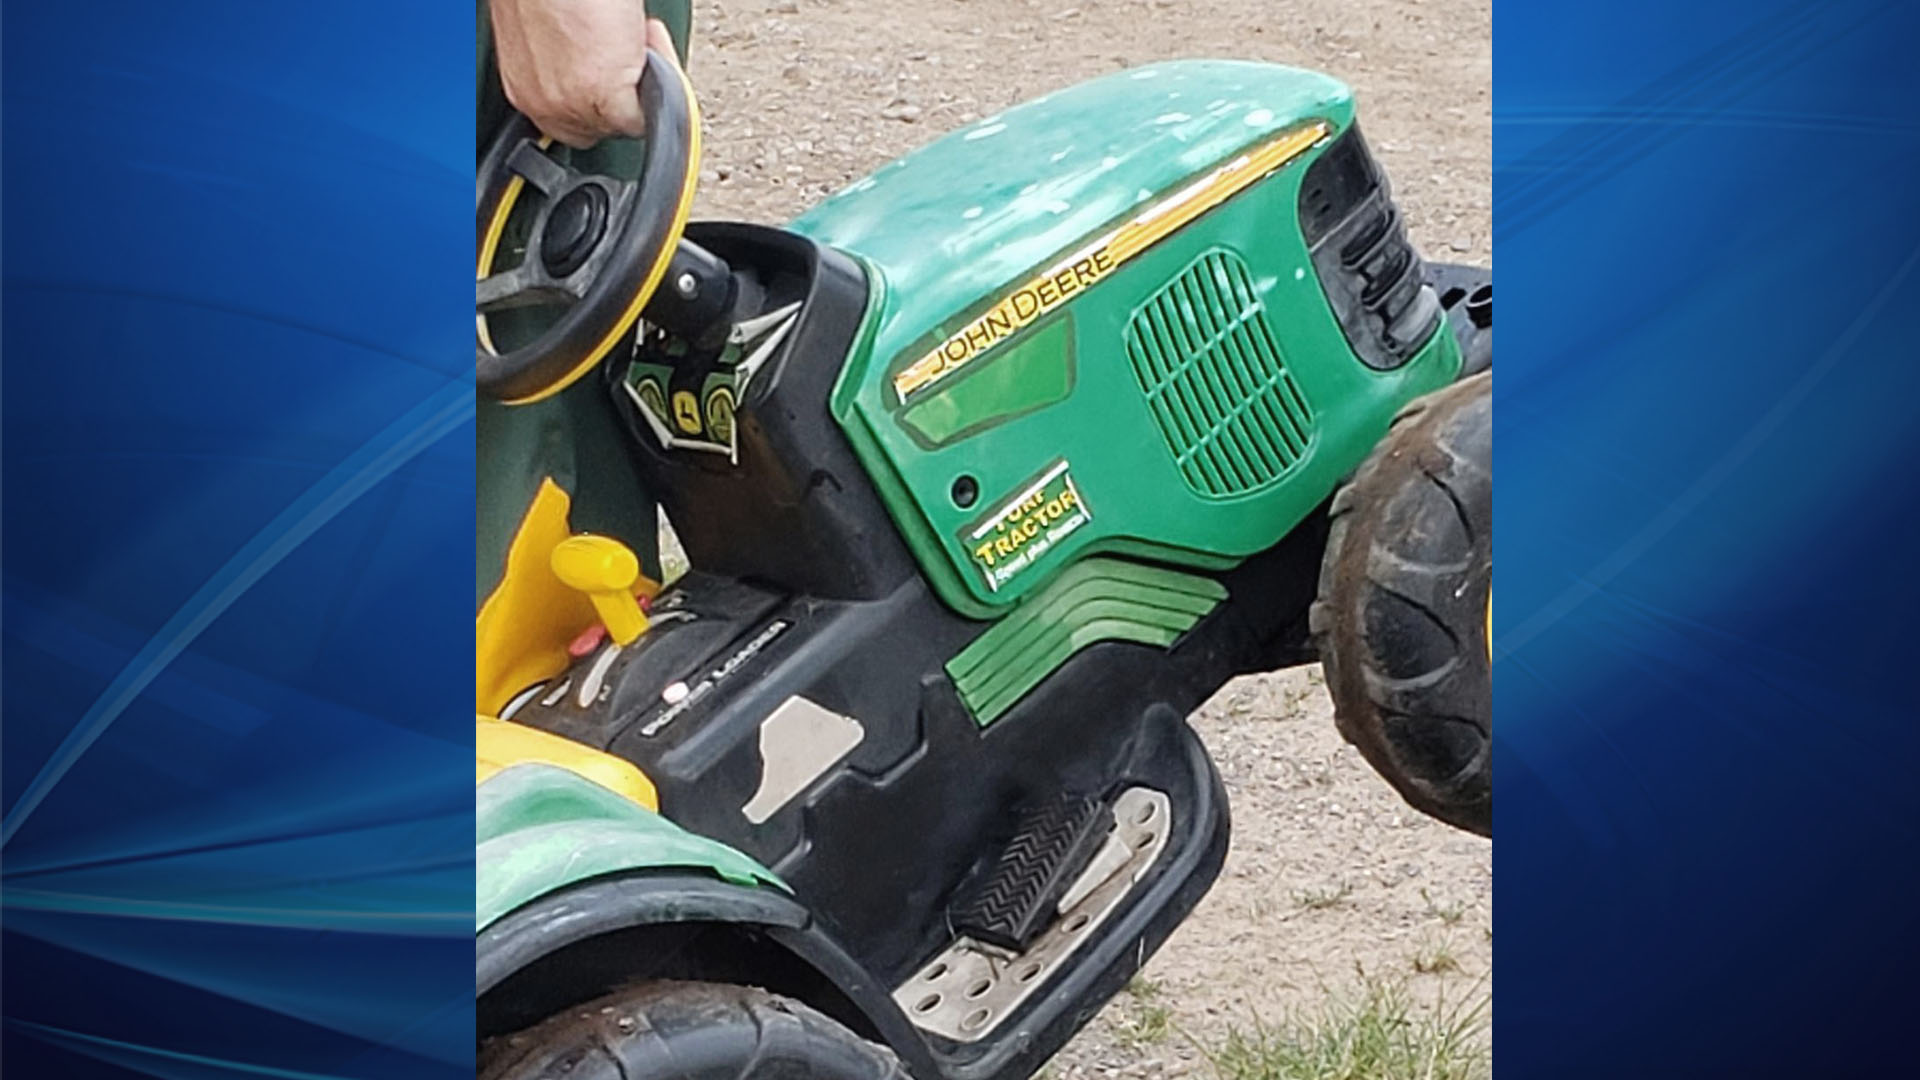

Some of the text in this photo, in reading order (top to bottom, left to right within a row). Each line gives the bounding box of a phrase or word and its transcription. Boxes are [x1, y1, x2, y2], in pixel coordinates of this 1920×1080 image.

[932, 246, 1115, 374] JOHN DEERE
[976, 490, 1076, 566] TRACTOR
